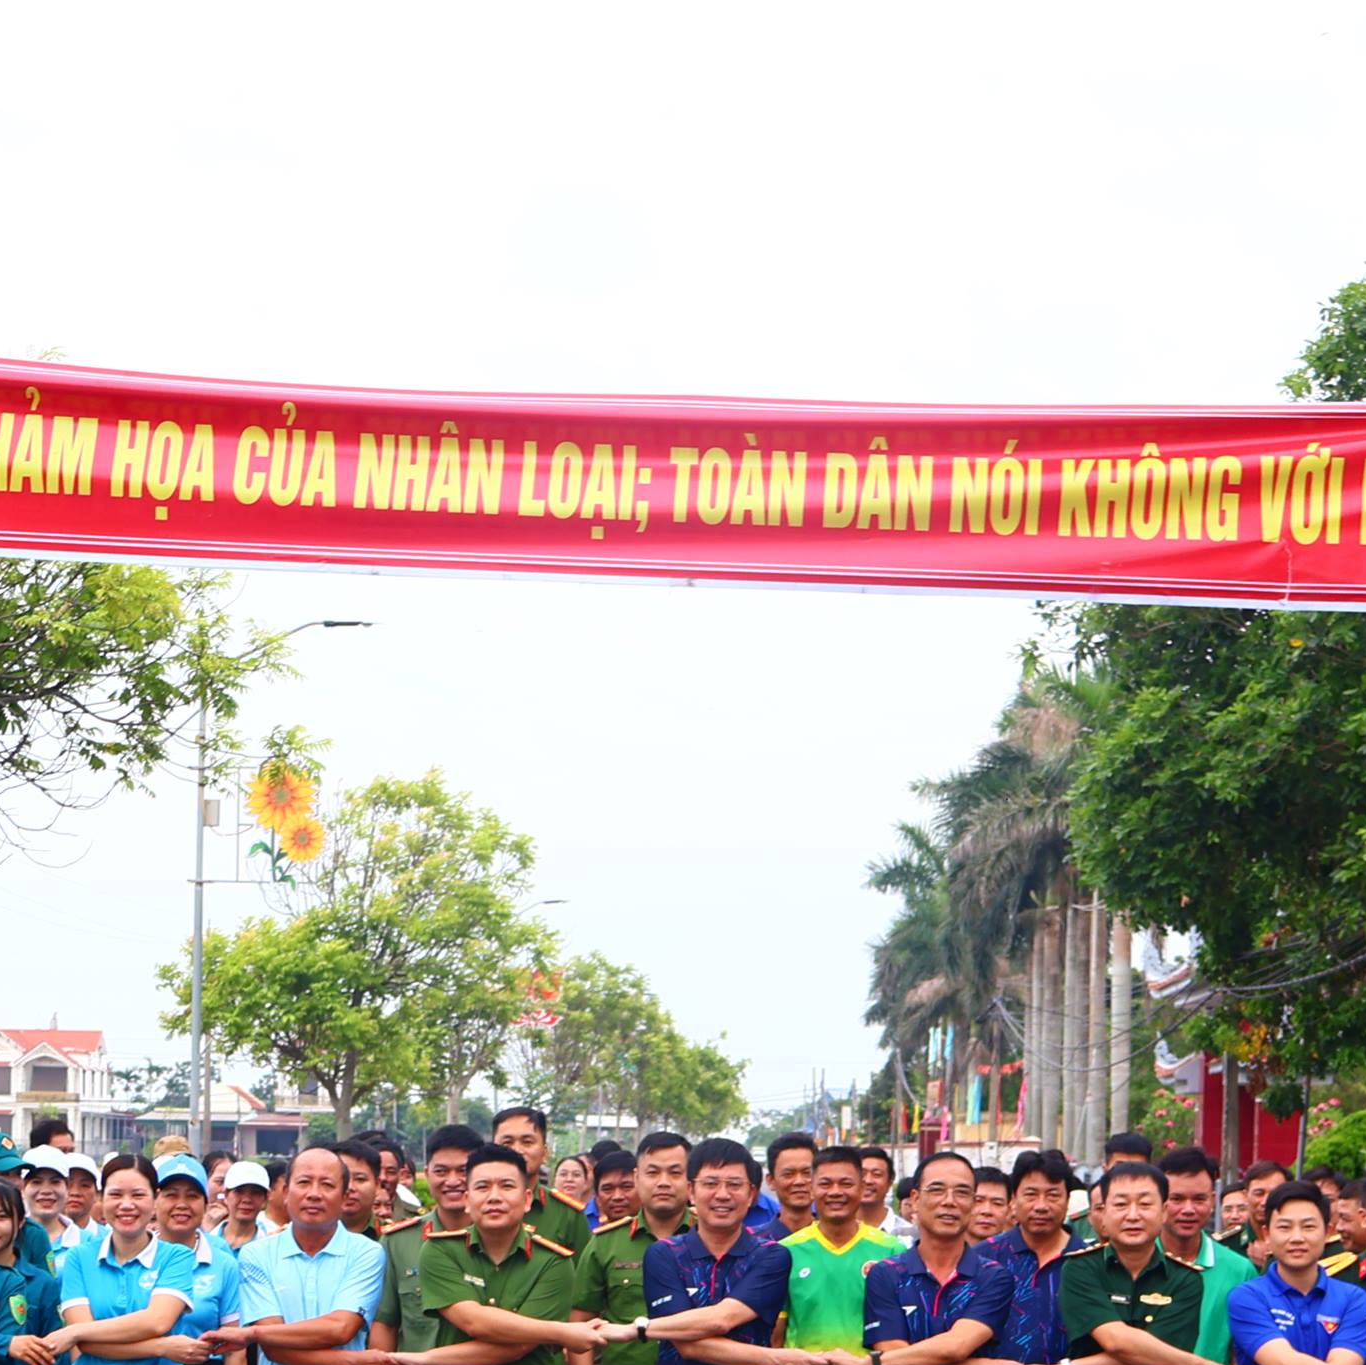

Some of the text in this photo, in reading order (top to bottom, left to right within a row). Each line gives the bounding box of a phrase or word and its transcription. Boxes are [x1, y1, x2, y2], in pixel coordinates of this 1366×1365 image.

[110, 419, 215, 521] HỌA
[233, 402, 336, 508] CỦA
[353, 421, 505, 515] NHÂN
[518, 441, 652, 539] LOẠI;
[670, 432, 807, 526] TOÀN
[823, 436, 934, 531] DÂN
[949, 439, 1043, 536] NÓI
[1057, 442, 1243, 541] KHÔNG
[1259, 441, 1345, 545] VỚI
